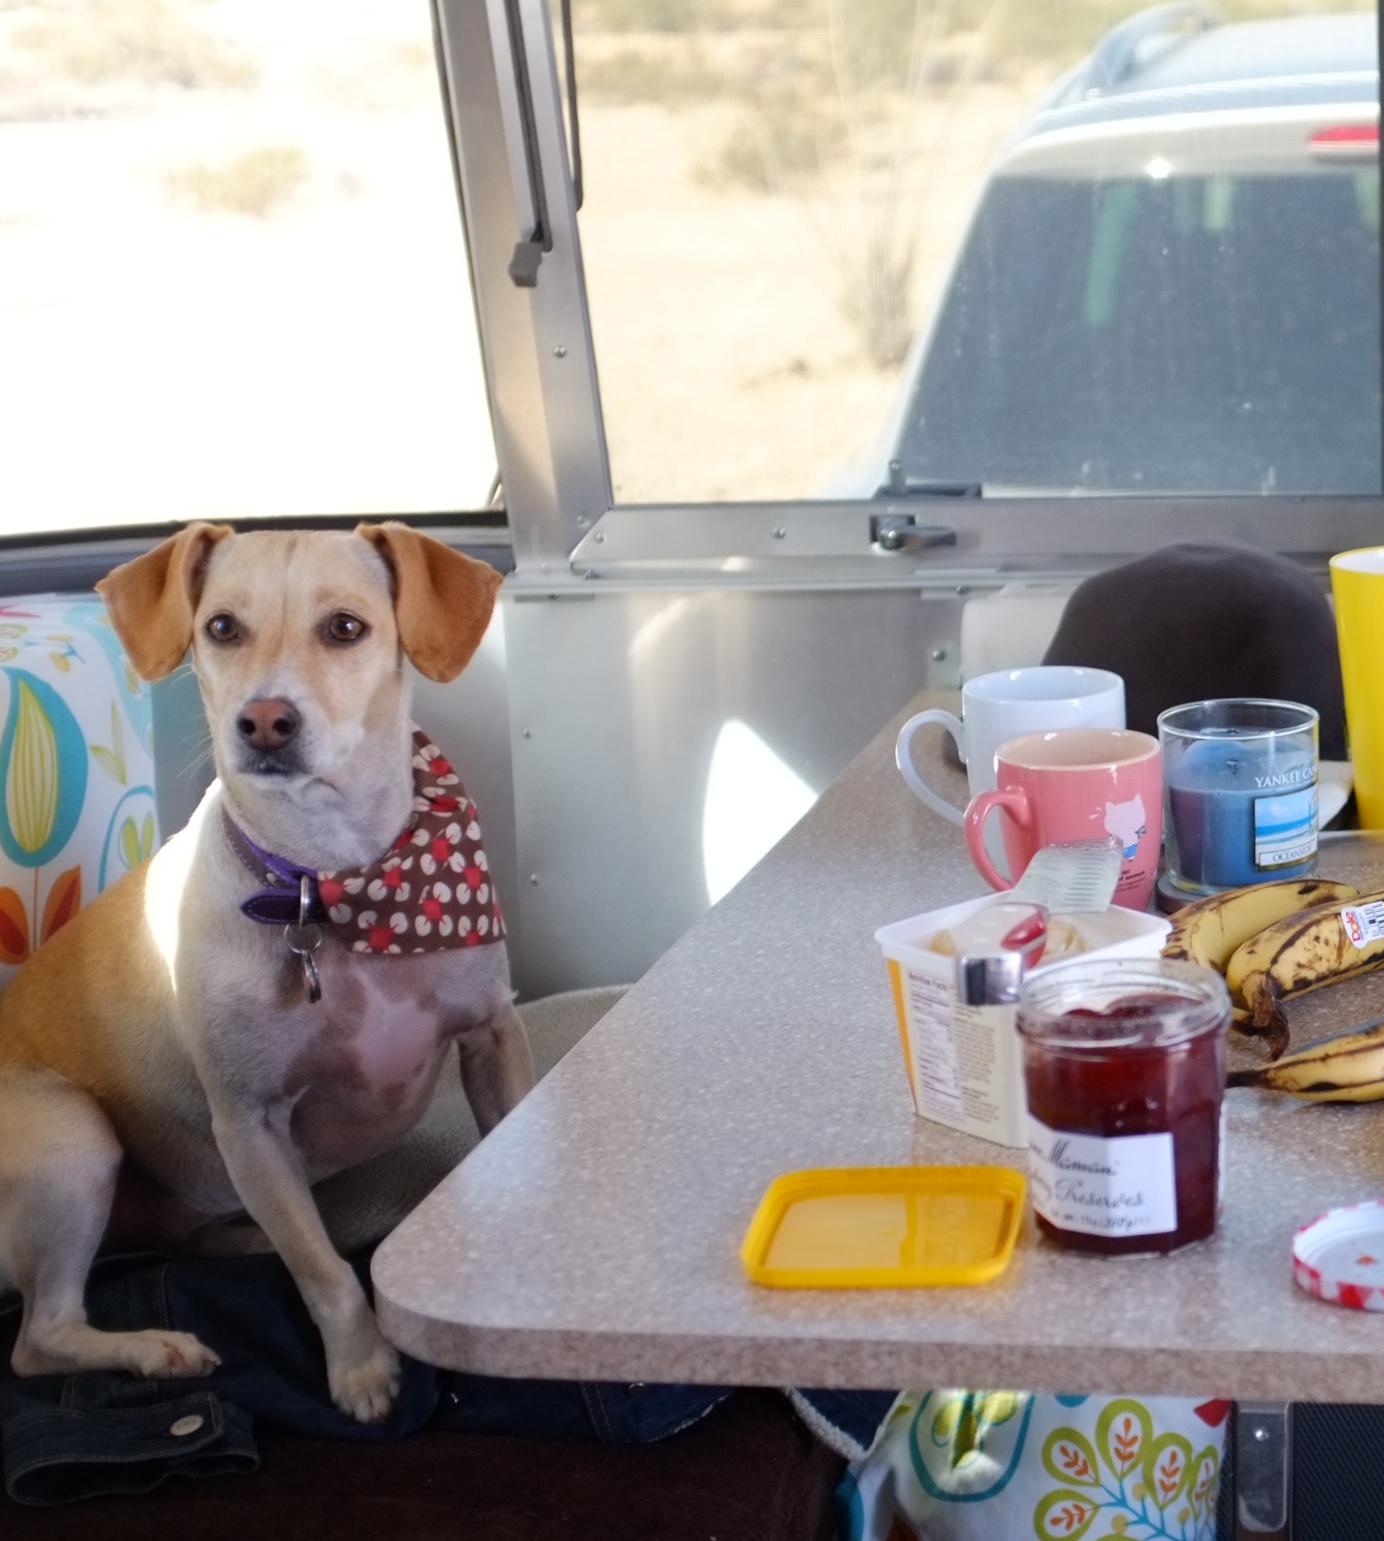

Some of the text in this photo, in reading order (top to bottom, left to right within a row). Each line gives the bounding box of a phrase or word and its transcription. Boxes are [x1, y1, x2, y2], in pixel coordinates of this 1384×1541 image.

[1254, 771, 1300, 789] YANKEE
[1302, 765, 1318, 780] CAN
[1272, 845, 1312, 863] OCEANSIDE
[1346, 911, 1361, 942] Dole
[1054, 1176, 1144, 1208] Preserves
